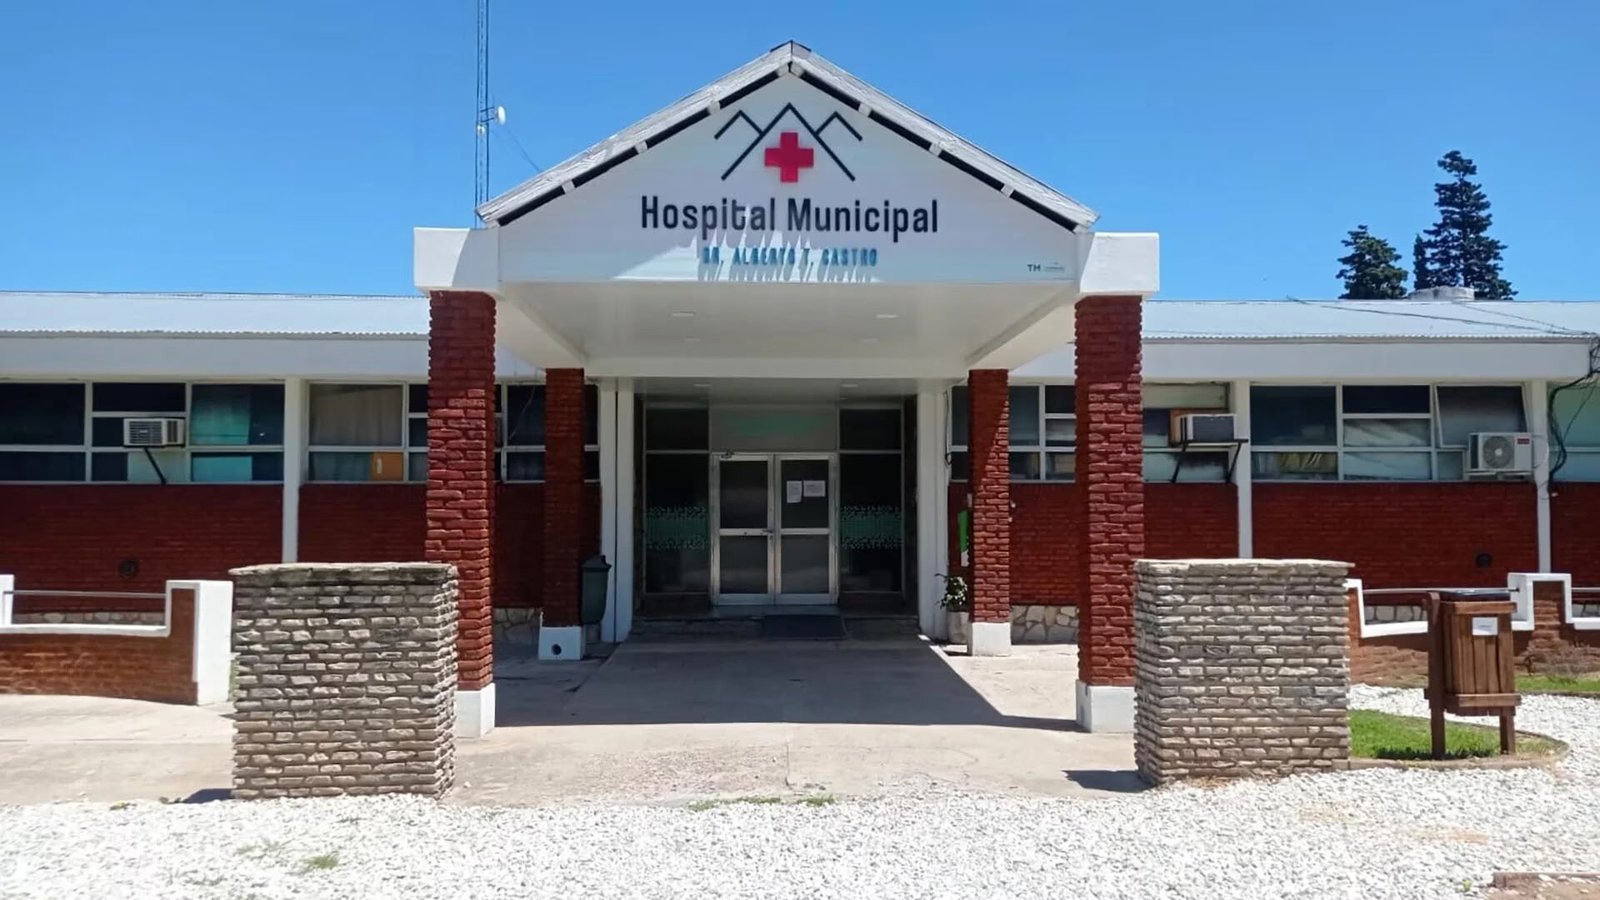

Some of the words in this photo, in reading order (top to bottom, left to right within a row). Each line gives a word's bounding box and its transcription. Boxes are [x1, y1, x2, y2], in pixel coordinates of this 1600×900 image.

[641, 195, 775, 239] Hospital
[787, 197, 938, 243] Municipal
[733, 246, 796, 266] ALBERTO
[822, 248, 878, 267] CASTRO
